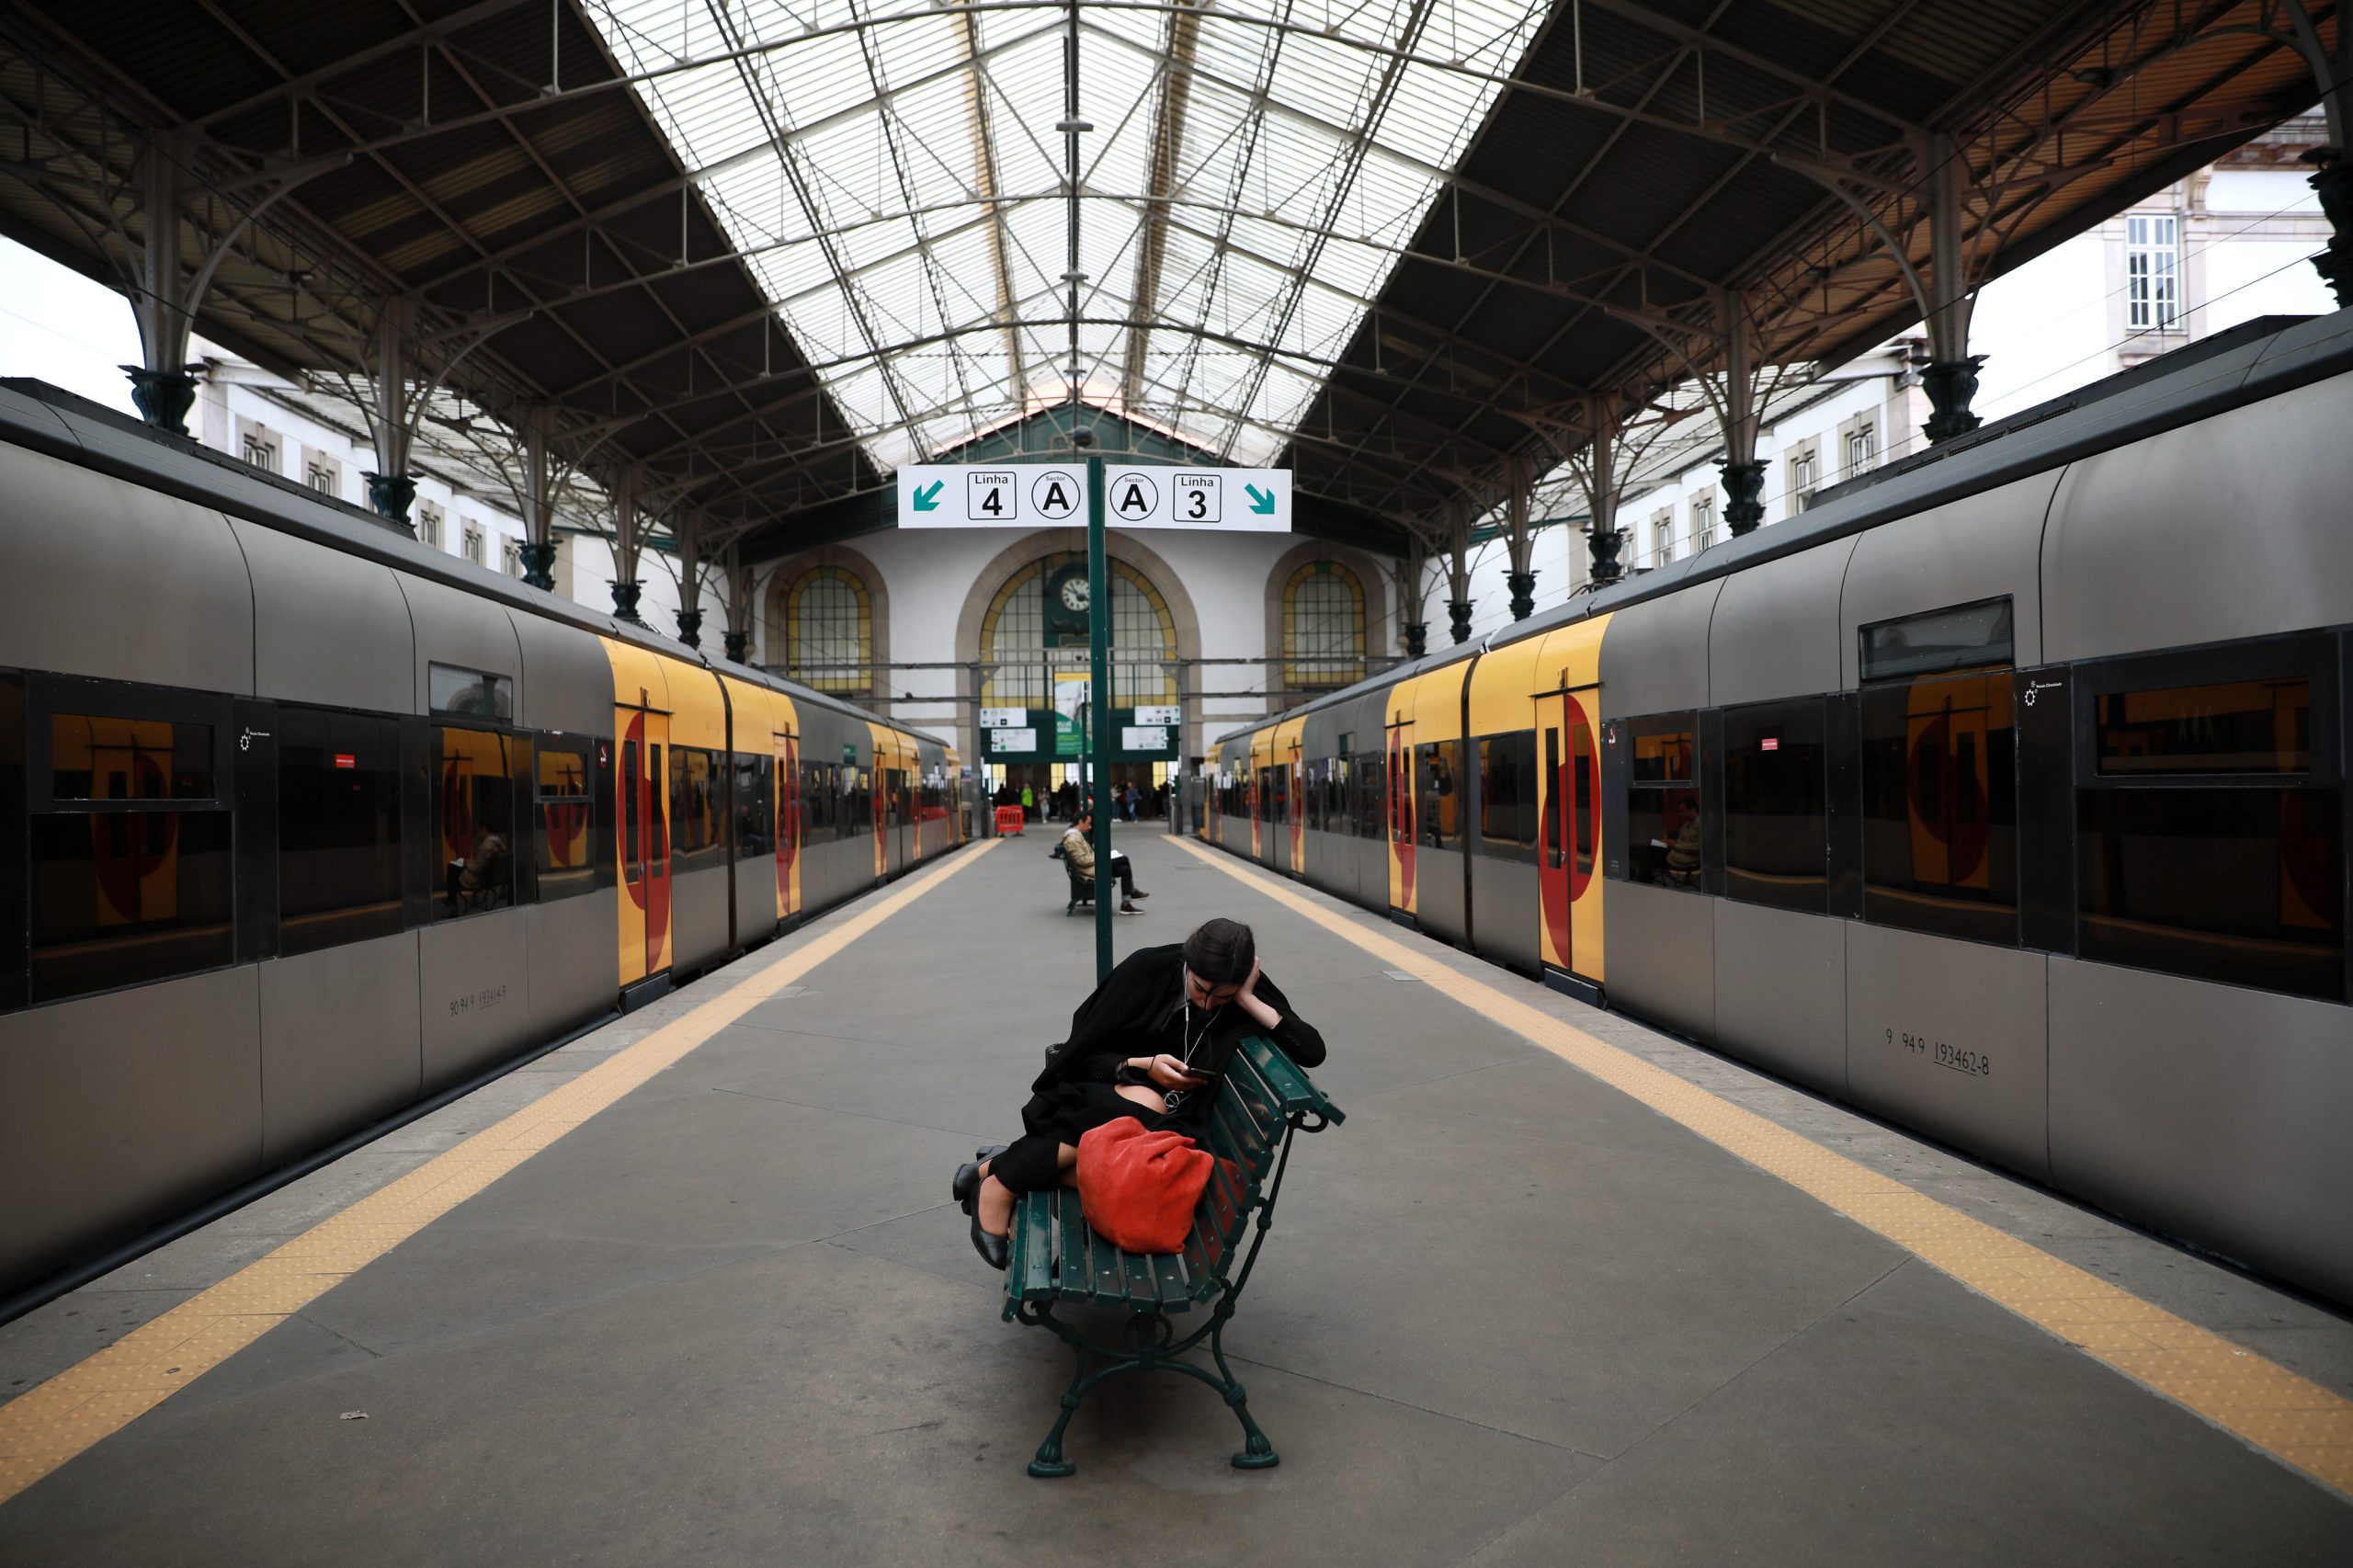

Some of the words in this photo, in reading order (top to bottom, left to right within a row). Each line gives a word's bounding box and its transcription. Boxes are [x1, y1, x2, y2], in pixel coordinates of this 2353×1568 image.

[974, 474, 1008, 484] Linha
[1180, 476, 1214, 487] Linha
[982, 487, 1003, 517] 4
[1042, 482, 1071, 511] A
[1120, 483, 1148, 513] A
[1188, 490, 1207, 519] 3
[1935, 1041, 1990, 1075] 193462-8
